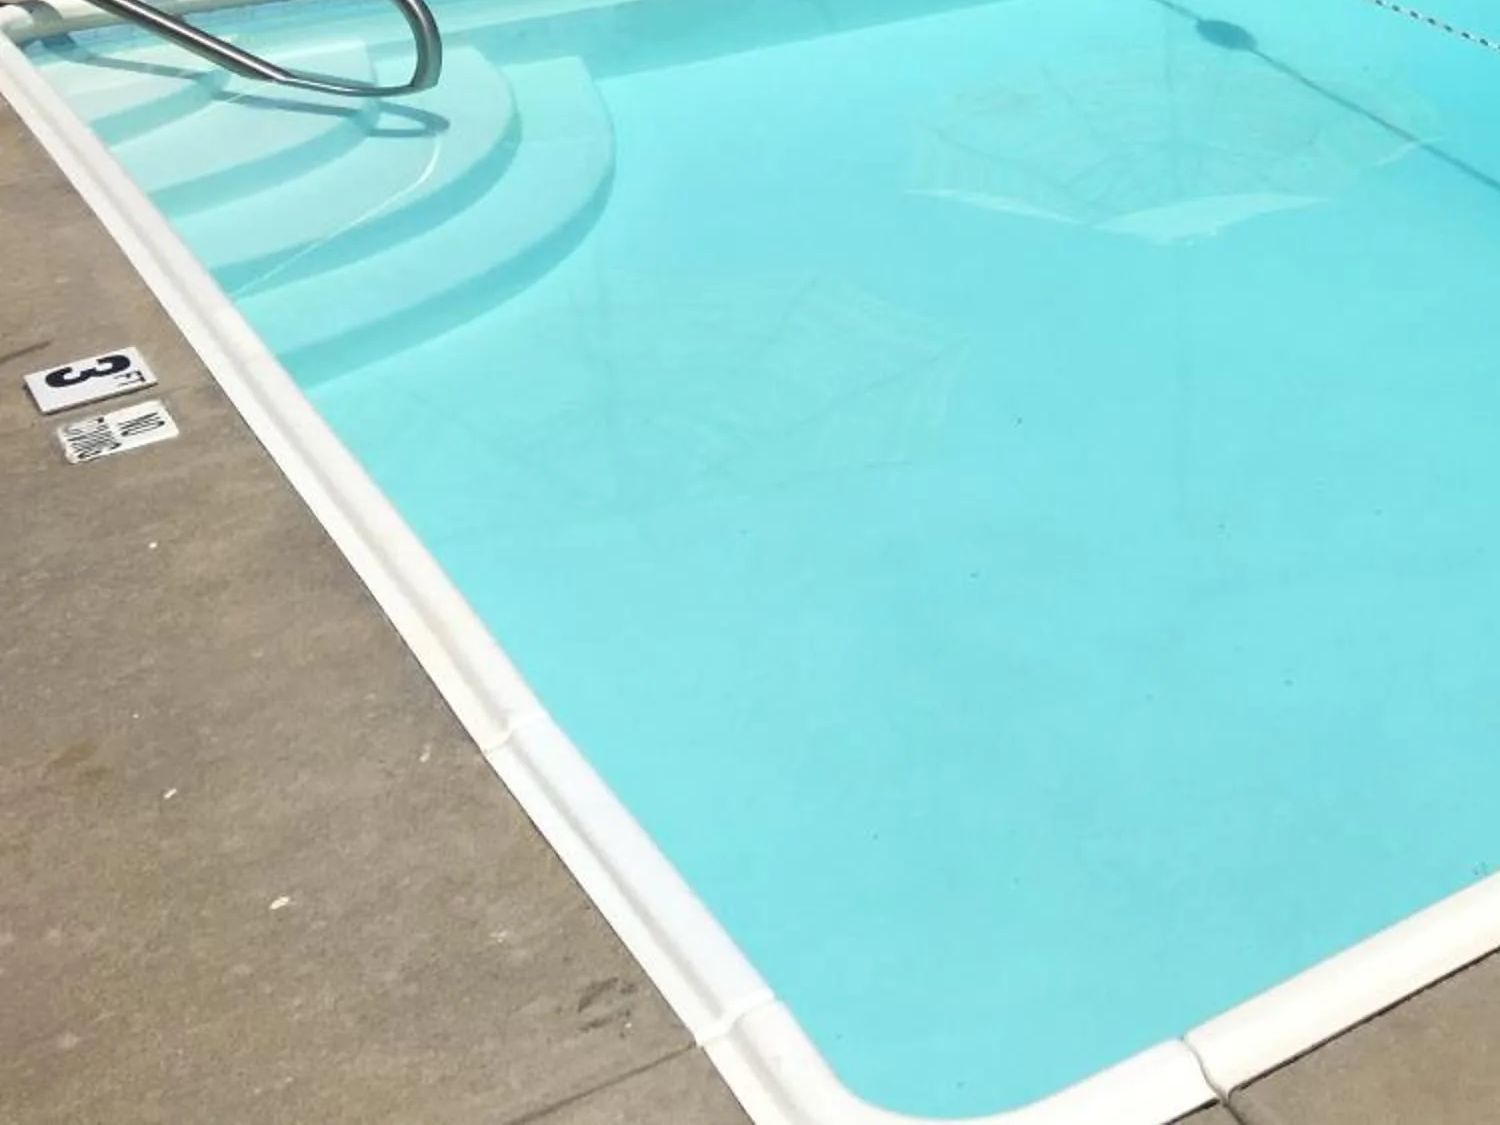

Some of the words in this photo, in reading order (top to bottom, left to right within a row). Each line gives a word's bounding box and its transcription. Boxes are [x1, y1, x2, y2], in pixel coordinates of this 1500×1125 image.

[45, 354, 131, 388] 3
[113, 370, 146, 387] FT
[116, 412, 165, 437] NO
